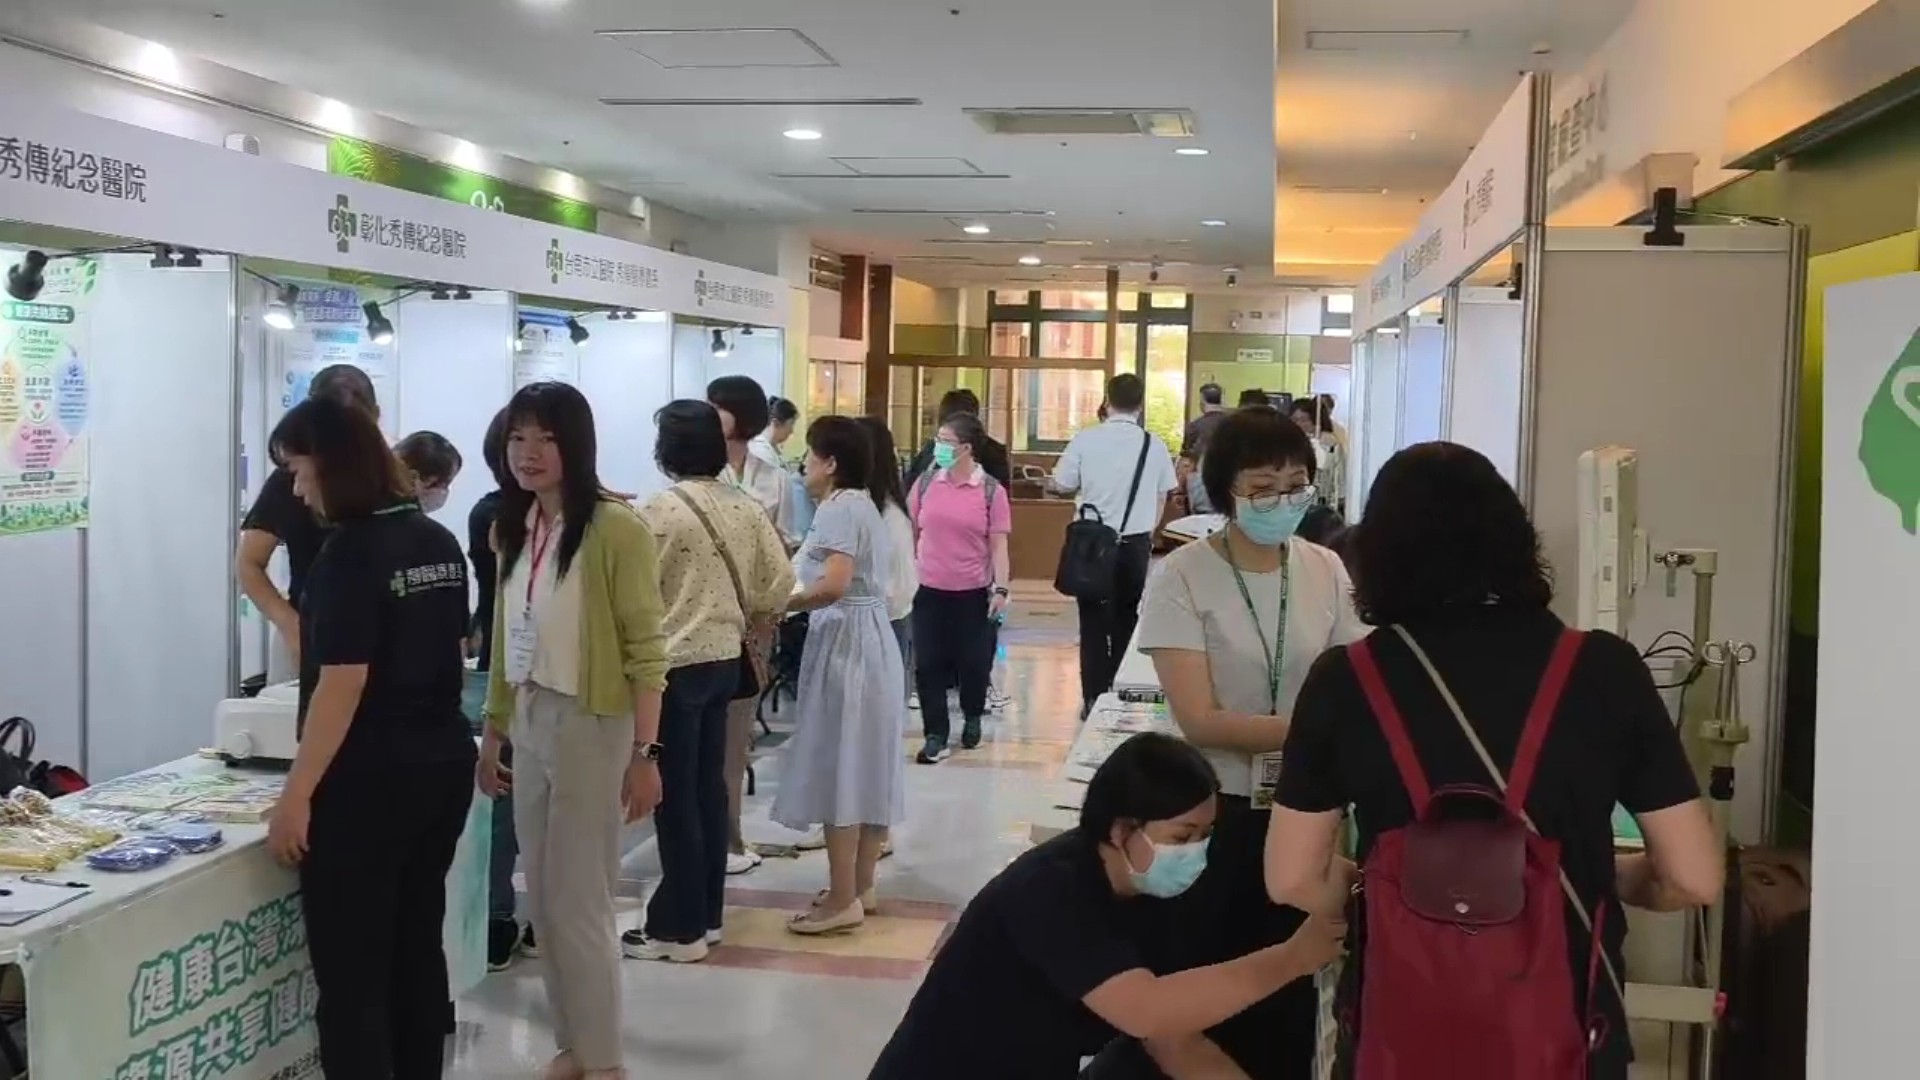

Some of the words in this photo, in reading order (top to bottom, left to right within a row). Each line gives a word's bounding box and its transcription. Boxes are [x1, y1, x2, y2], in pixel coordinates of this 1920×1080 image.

[0, 137, 147, 203] 秀傳紀念醫院
[360, 213, 467, 259] 彰化秀傳紀念醫院
